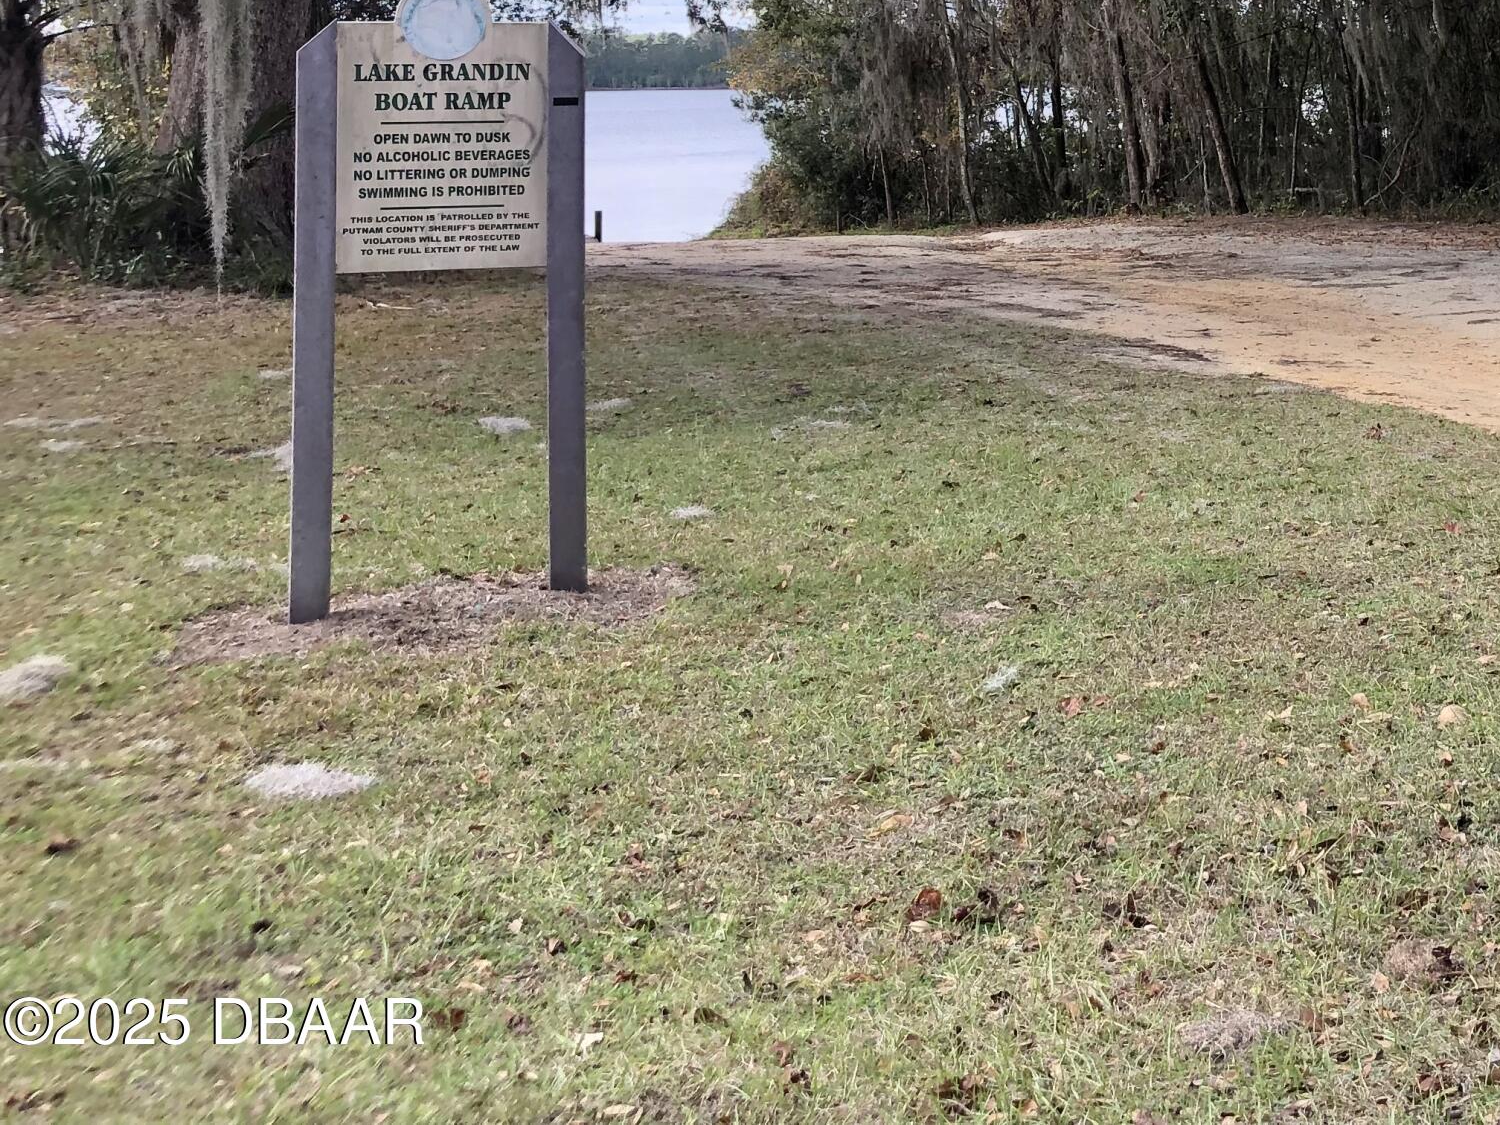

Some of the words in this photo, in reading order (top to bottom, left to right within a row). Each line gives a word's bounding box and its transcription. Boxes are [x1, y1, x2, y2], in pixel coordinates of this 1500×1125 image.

[354, 64, 415, 82] LAKE
[423, 63, 531, 81] GRANDIN
[375, 93, 437, 111] BOAT
[445, 92, 511, 110] RAMP
[374, 134, 408, 144] OPEN
[414, 133, 450, 143] DAWN
[456, 133, 471, 143] TO
[476, 132, 510, 143] DUSK
[354, 152, 372, 163] NO
[377, 151, 450, 162] ALCOHOLIC
[455, 150, 530, 161] BEVERAGES
[354, 170, 372, 180] NO
[377, 169, 445, 180] LITTERING
[450, 168, 467, 179] OR
[472, 167, 530, 178] DUMPING
[359, 187, 427, 198] SWIMMING
[432, 187, 443, 197] IS
[448, 185, 525, 196] PROHIBITED
[376, 215, 423, 223] LOCATION
[479, 223, 539, 231] DEPARTMENT
[363, 236, 416, 244] VIOLATORS
[459, 234, 520, 242] PROSECUTED
